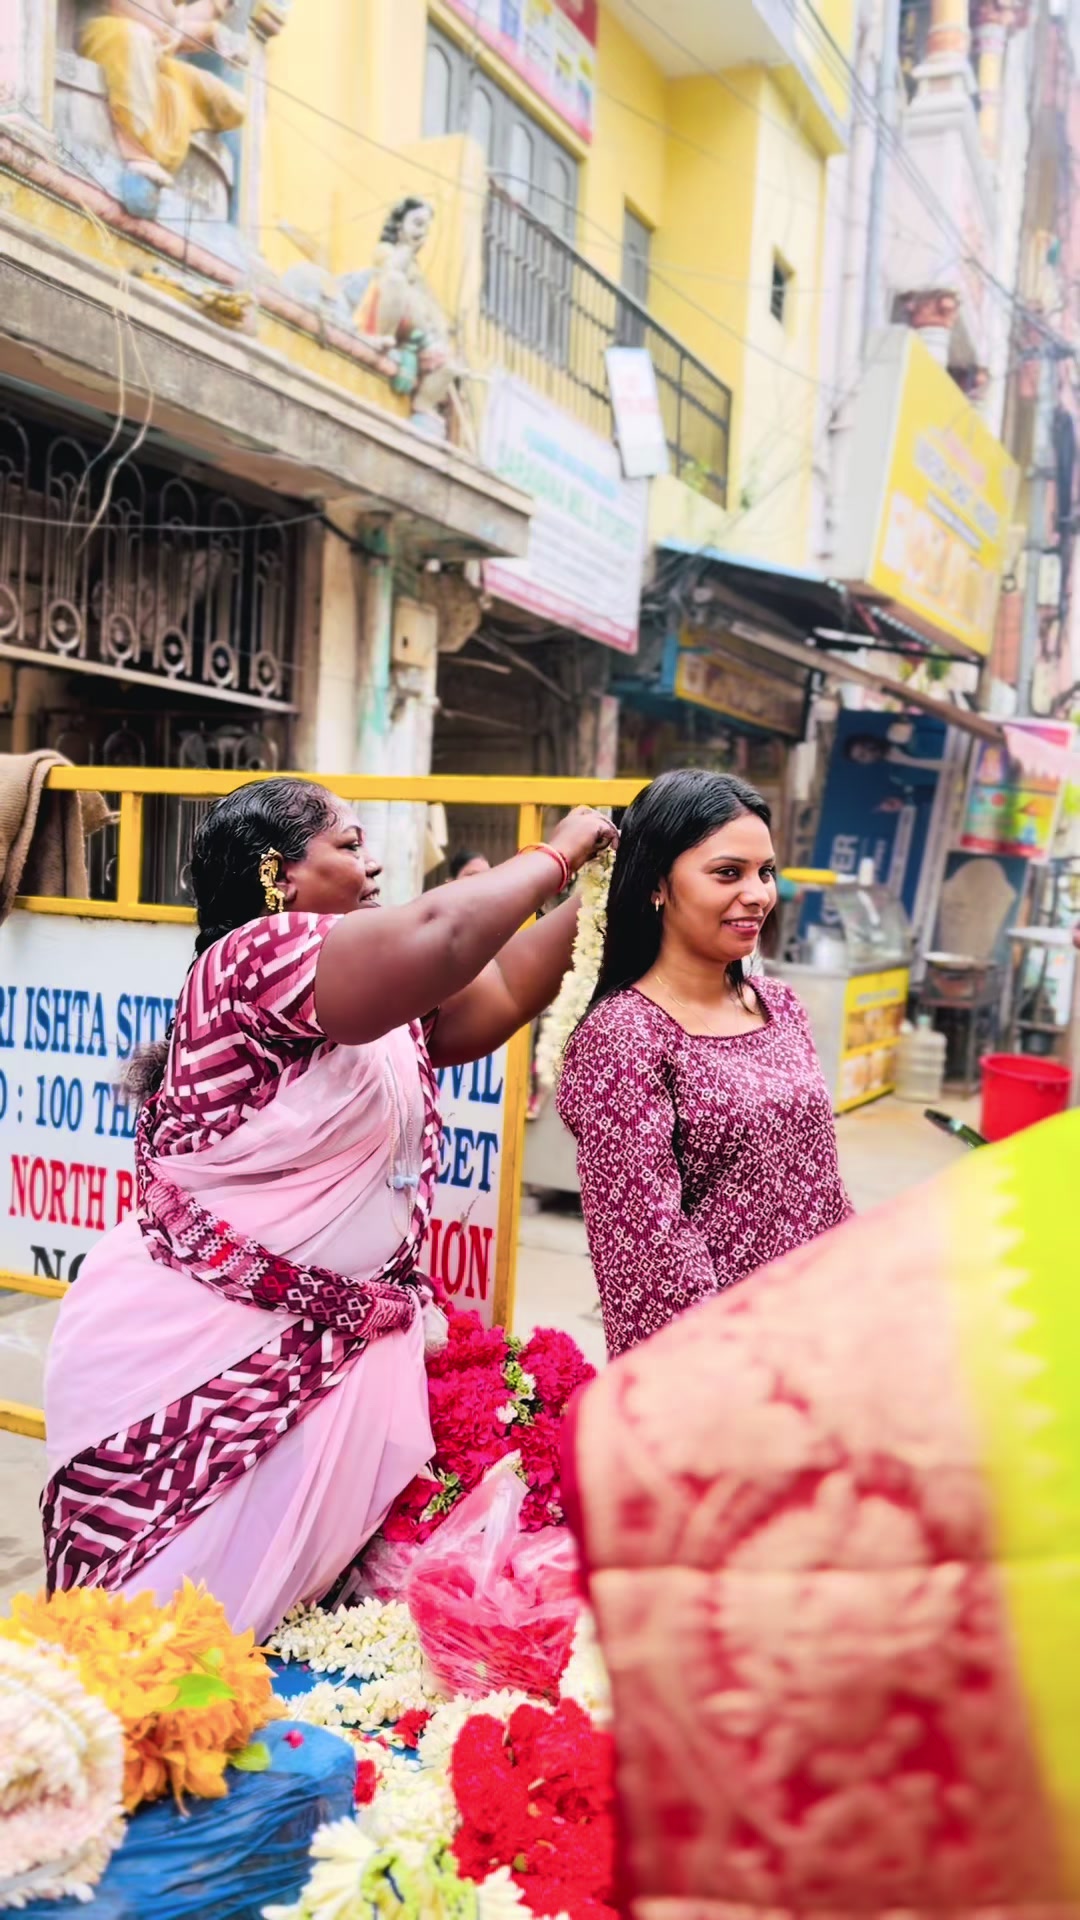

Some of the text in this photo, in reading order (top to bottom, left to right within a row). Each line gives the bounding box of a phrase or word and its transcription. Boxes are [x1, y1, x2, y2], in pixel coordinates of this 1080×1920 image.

[24, 986, 108, 1057] ISHTA
[436, 1052, 504, 1104] VIL
[35, 1074, 83, 1132] 100
[92, 1081, 137, 1138] TH
[8, 1154, 107, 1231] NORTH
[426, 1218, 493, 1300] ION
